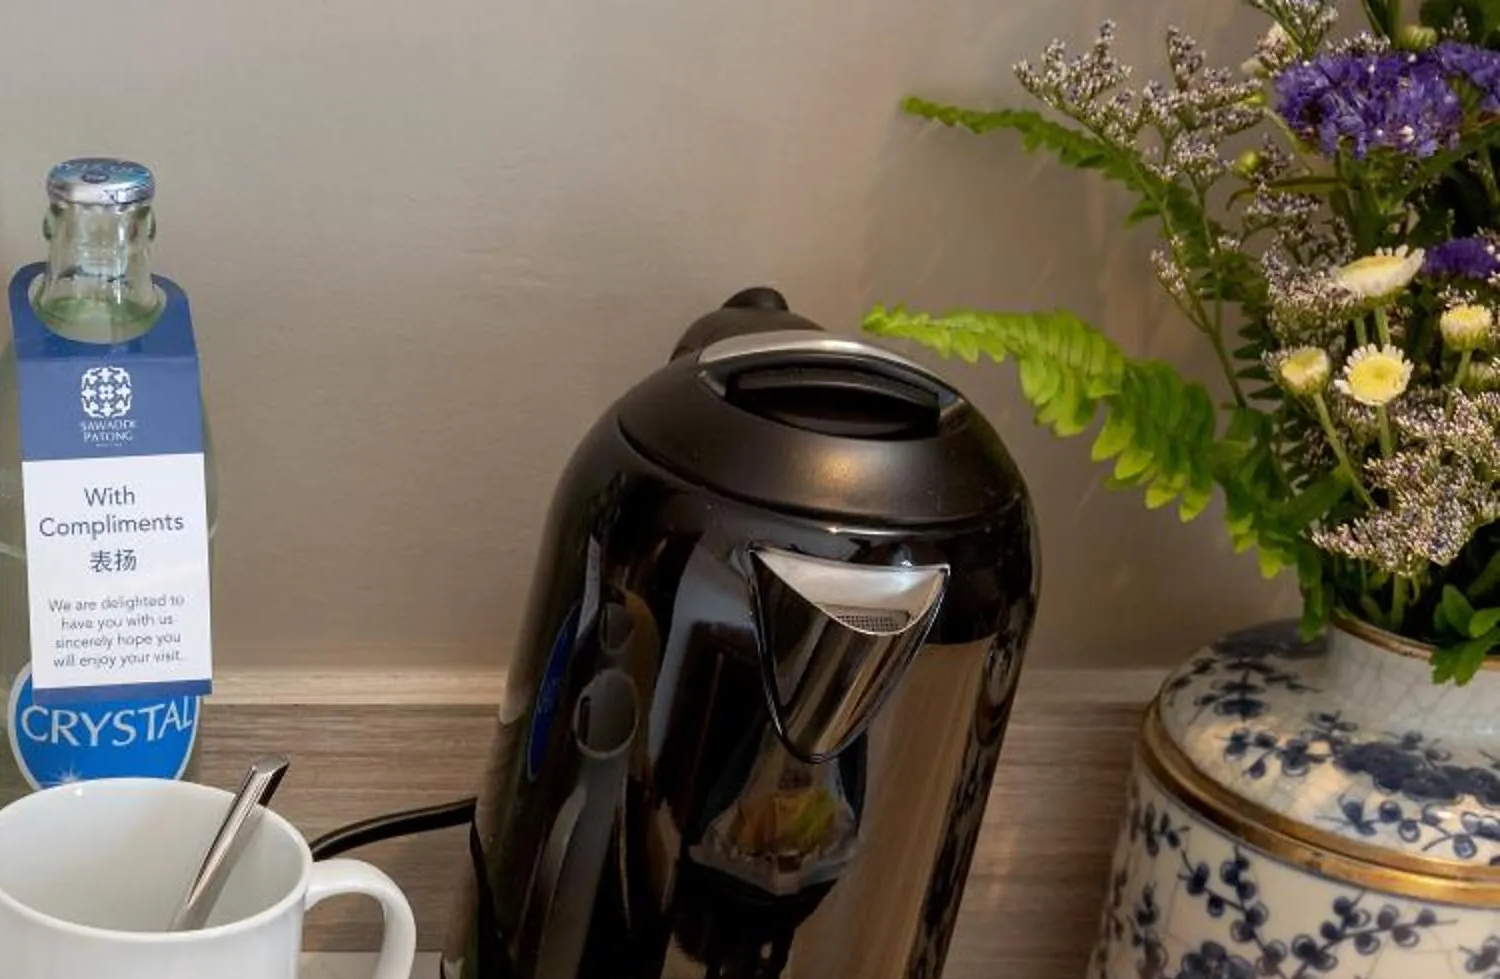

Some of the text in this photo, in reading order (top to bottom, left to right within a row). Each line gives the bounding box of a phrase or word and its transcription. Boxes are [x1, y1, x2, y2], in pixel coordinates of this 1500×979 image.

[83, 431, 133, 442] PATONG
[84, 485, 135, 507] With
[39, 513, 185, 540] Compliments
[90, 548, 137, 573] 表扬
[49, 594, 185, 612] We are delighted to
[61, 613, 173, 631] have you with us
[55, 632, 181, 650] sincerely hope you
[53, 655, 75, 667] will
[79, 655, 116, 668] enjoy
[120, 654, 150, 668] your
[21, 696, 192, 747] CRYSTAL
